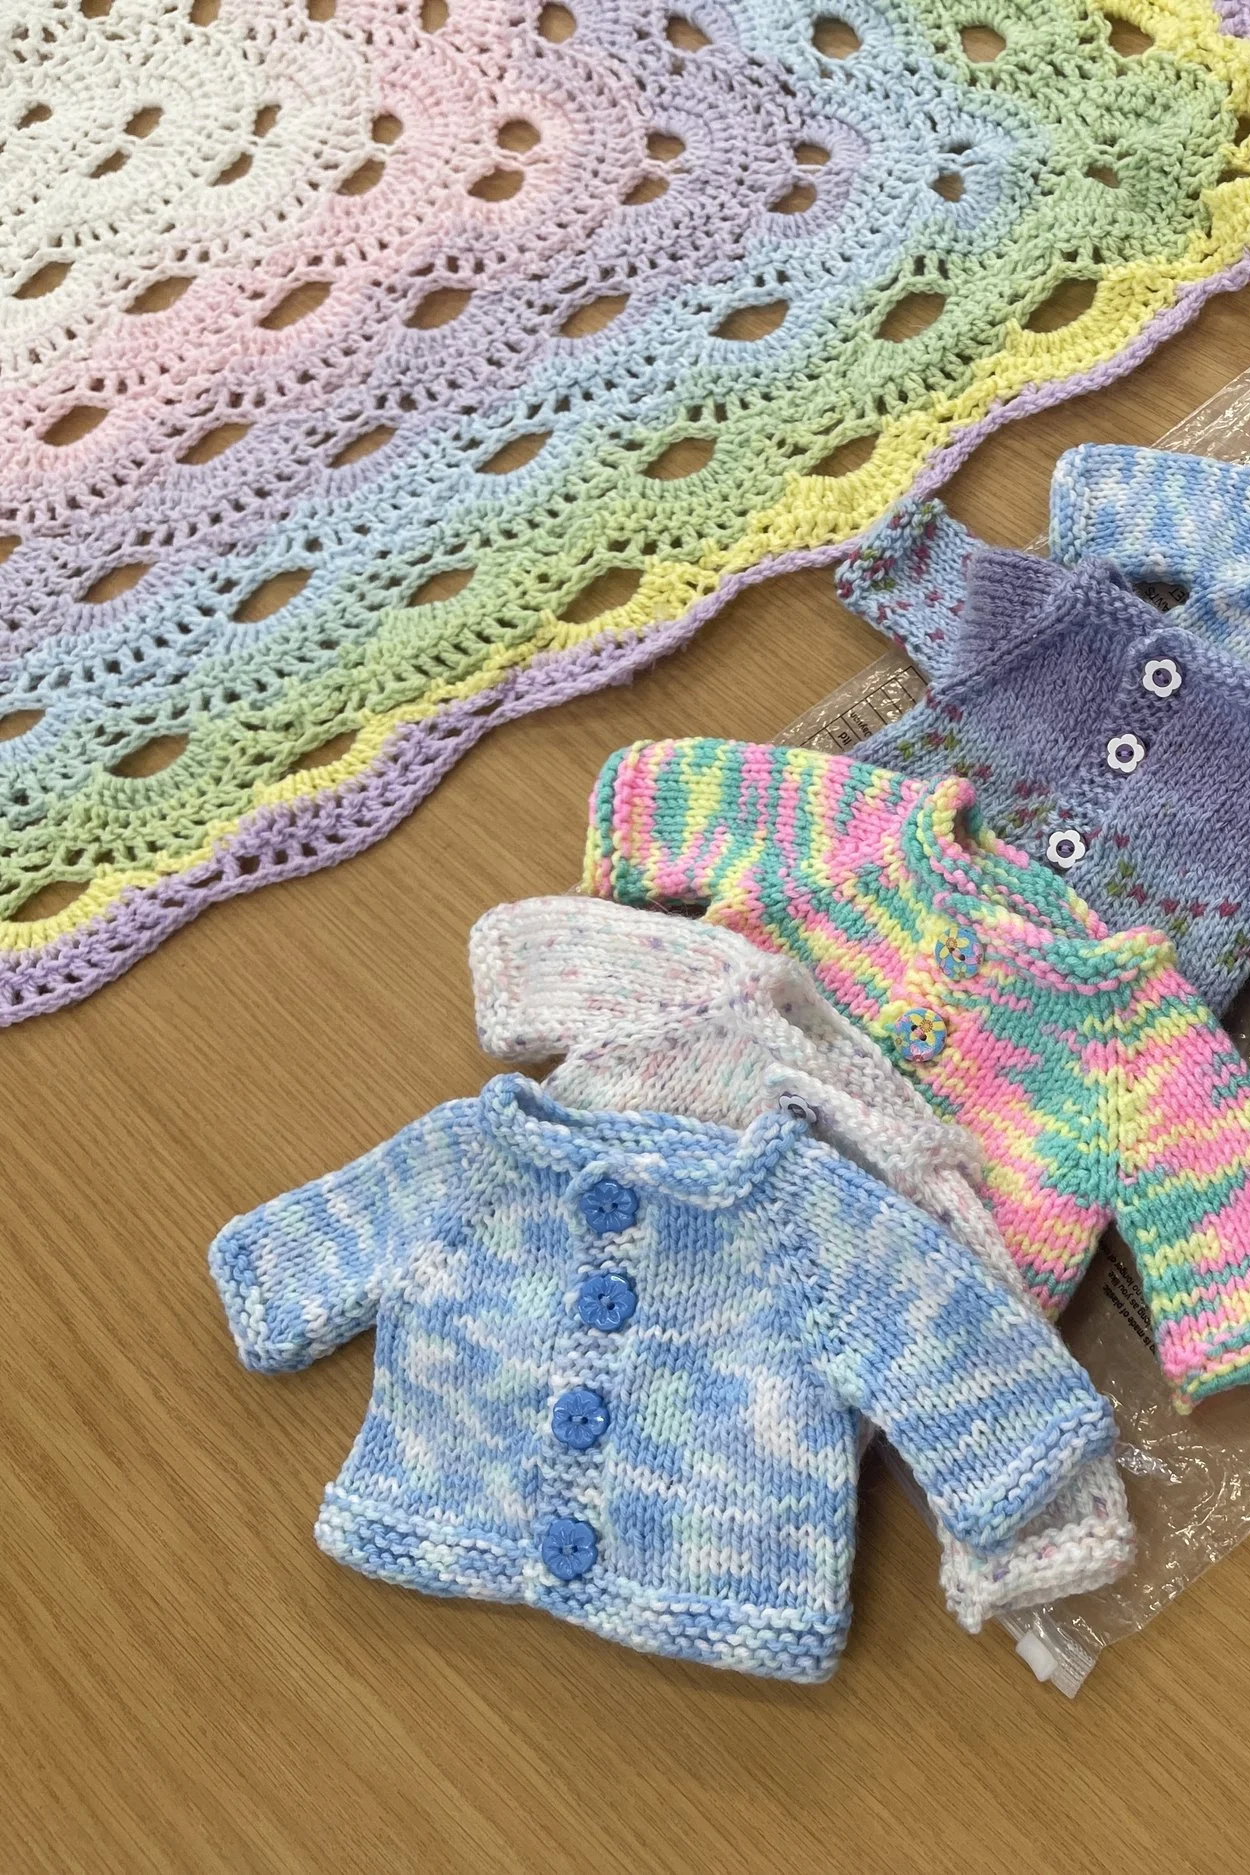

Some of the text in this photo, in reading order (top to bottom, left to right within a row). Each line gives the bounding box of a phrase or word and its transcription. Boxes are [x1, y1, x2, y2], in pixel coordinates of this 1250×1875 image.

[837, 730, 852, 745] ltd
[1116, 1282, 1133, 1300] you
[1128, 1298, 1140, 1309] as
[1118, 1307, 1130, 1318] of
[1125, 1315, 1145, 1338] made
